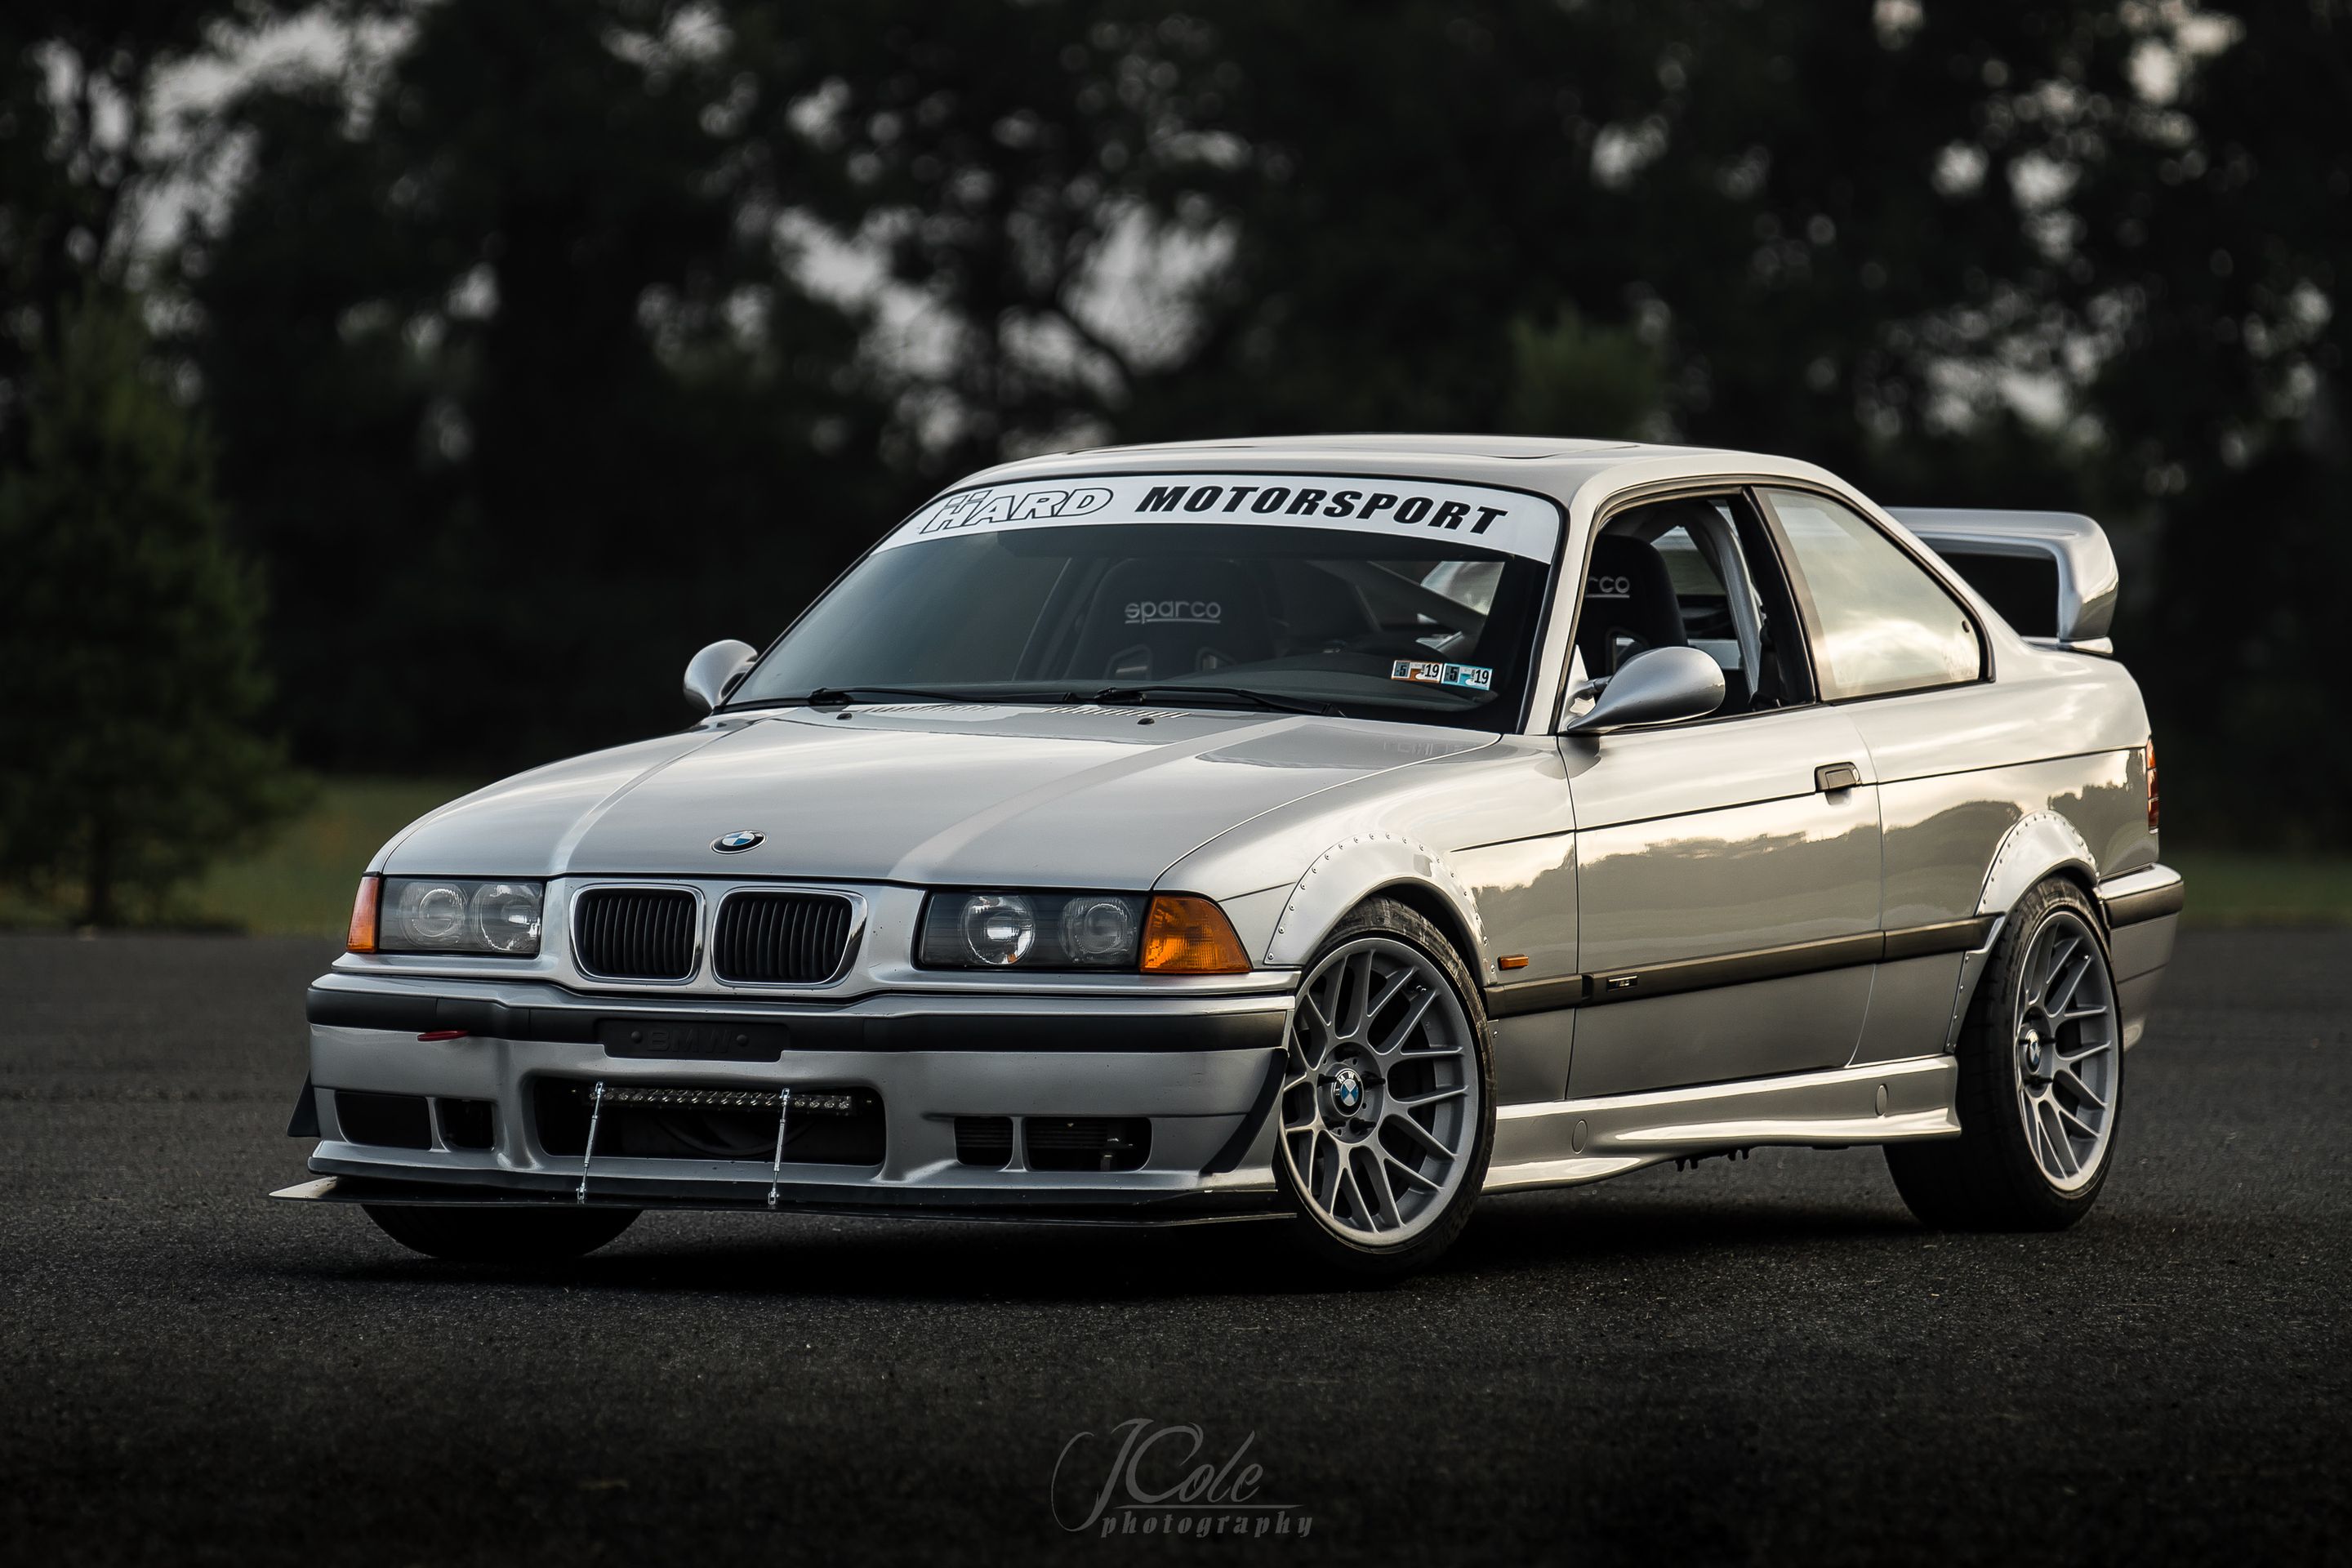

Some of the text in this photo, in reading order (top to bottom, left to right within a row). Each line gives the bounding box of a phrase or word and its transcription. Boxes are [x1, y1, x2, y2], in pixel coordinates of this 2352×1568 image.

[920, 486, 1508, 535] HARD MOTORSPORT
[1125, 600, 1221, 624] sparco
[1424, 663, 1440, 678] 19
[1474, 669, 1490, 684] 19
[647, 1027, 733, 1053] BMW
